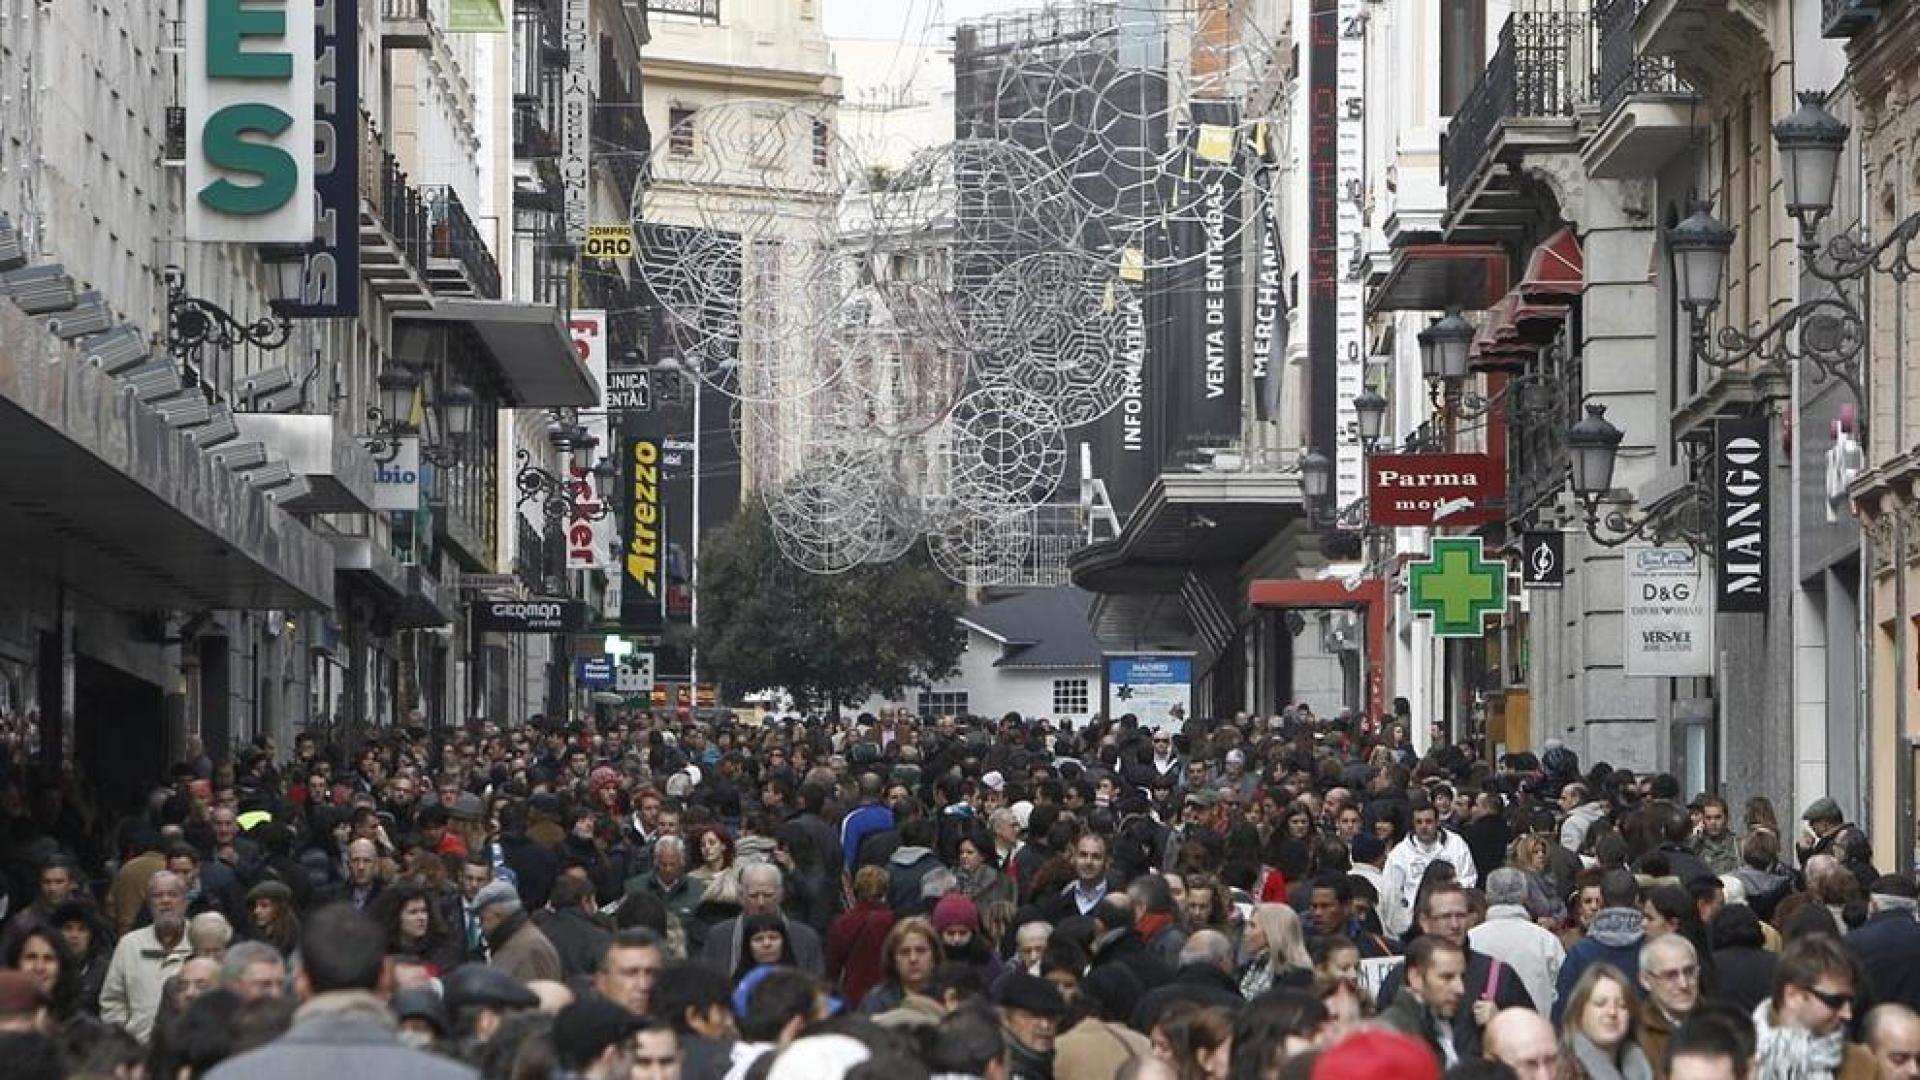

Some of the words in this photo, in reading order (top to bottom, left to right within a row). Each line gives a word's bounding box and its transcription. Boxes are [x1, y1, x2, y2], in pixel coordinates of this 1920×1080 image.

[1346, 96, 1363, 121] 15
[589, 226, 631, 236] COMPRO
[1206, 182, 1226, 294] ENTRADAS
[588, 238, 631, 255] ORO
[1206, 295, 1226, 327] DE
[1348, 341, 1359, 361] 0
[1206, 333, 1226, 399] VENTA
[375, 461, 416, 484] bio
[1377, 470, 1479, 488] Parma
[628, 440, 658, 598] Atrezzo
[1726, 437, 1762, 594] MANGO
[1643, 583, 1690, 602] D&G
